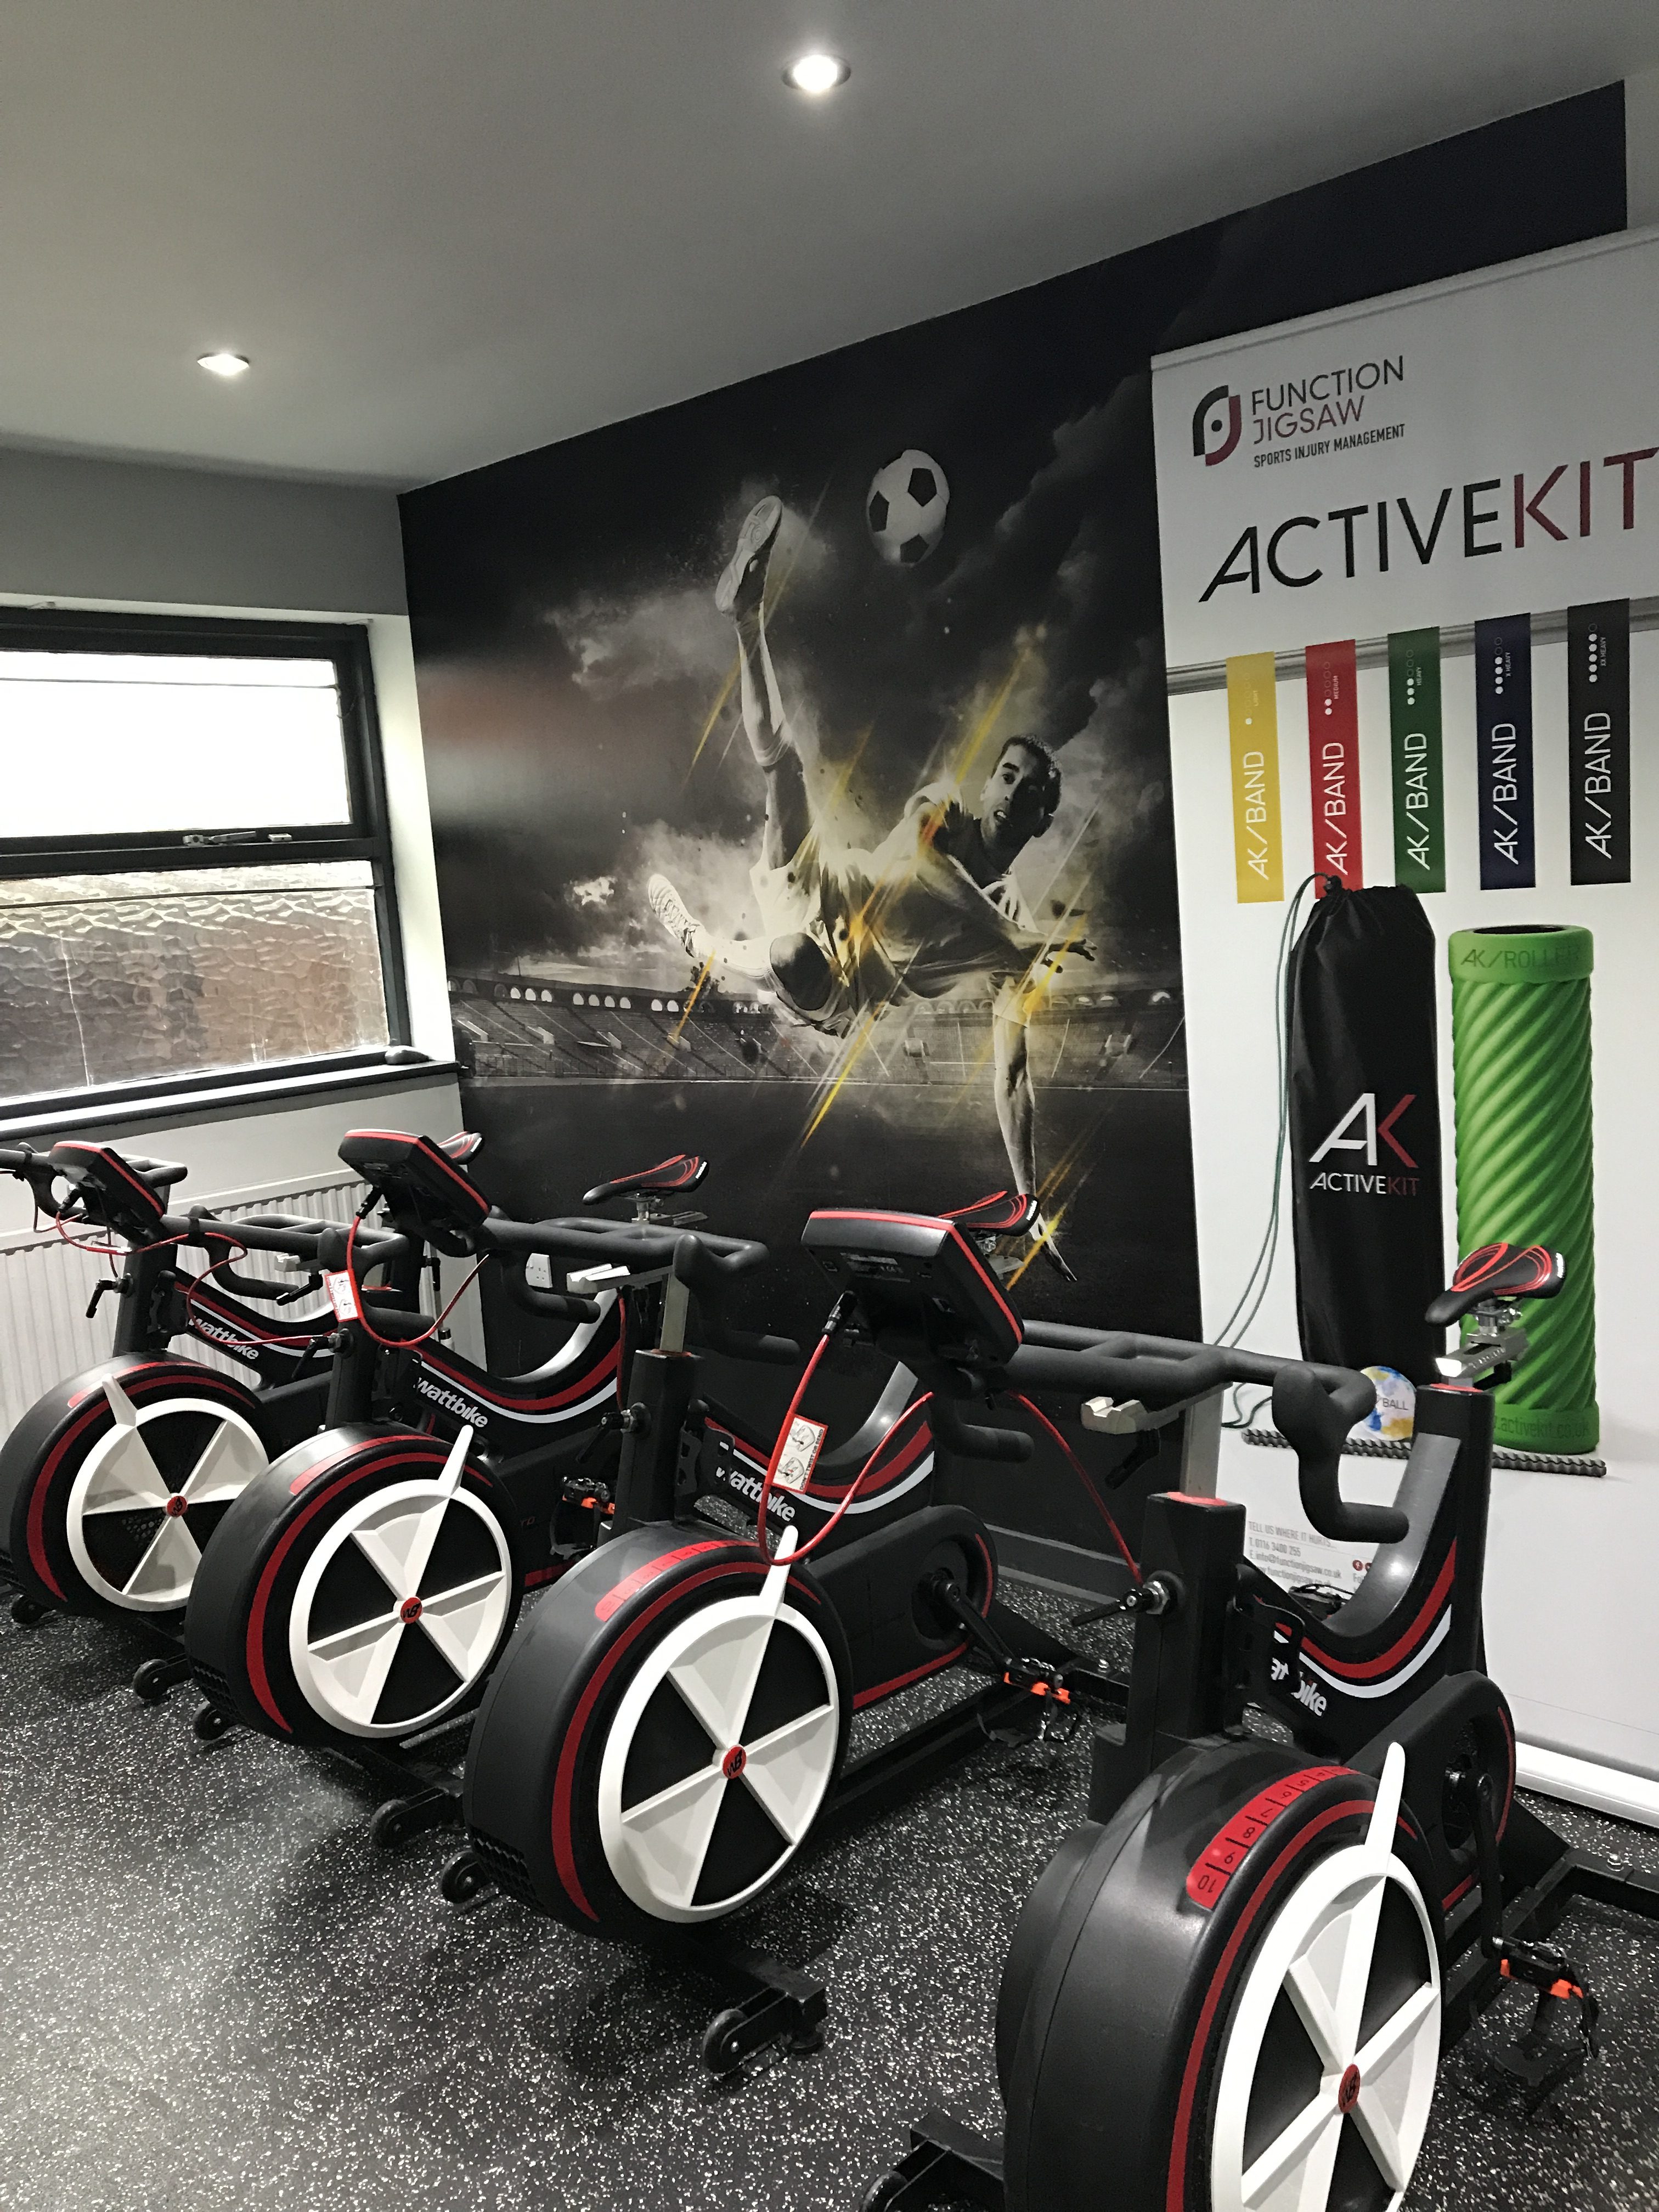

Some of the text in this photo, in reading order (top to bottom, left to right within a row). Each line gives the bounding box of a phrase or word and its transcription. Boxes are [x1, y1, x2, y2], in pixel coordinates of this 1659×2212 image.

[1252, 355, 1403, 415] FUNCTION
[1253, 395, 1365, 445] JIGSAW
[1254, 424, 1405, 468] SPORTS INJURY MANAGEMENT
[1198, 447, 1659, 603] ACTIVEKIT
[1243, 751, 1269, 881] AK/BAND
[1322, 742, 1348, 876] AK/BAND
[1404, 733, 1430, 871] AK/BAND
[1491, 723, 1519, 865] AK/BAND
[1584, 713, 1612, 860] AK/BAND
[1308, 1093, 1419, 1169] AK
[1310, 1172, 1420, 1196] ACTIVEKIT
[413, 1377, 488, 1427] wattbike
[1248, 1521, 1262, 1532] TELL
[1265, 1524, 1274, 1534] US
[1276, 1527, 1299, 1541] WHERE
[1301, 1532, 1307, 1541] IT
[1197, 1874, 1217, 1893] 10
[1223, 1850, 1234, 1865] 9
[1243, 1826, 1256, 1839] 8
[1260, 1808, 1273, 1818] 7
